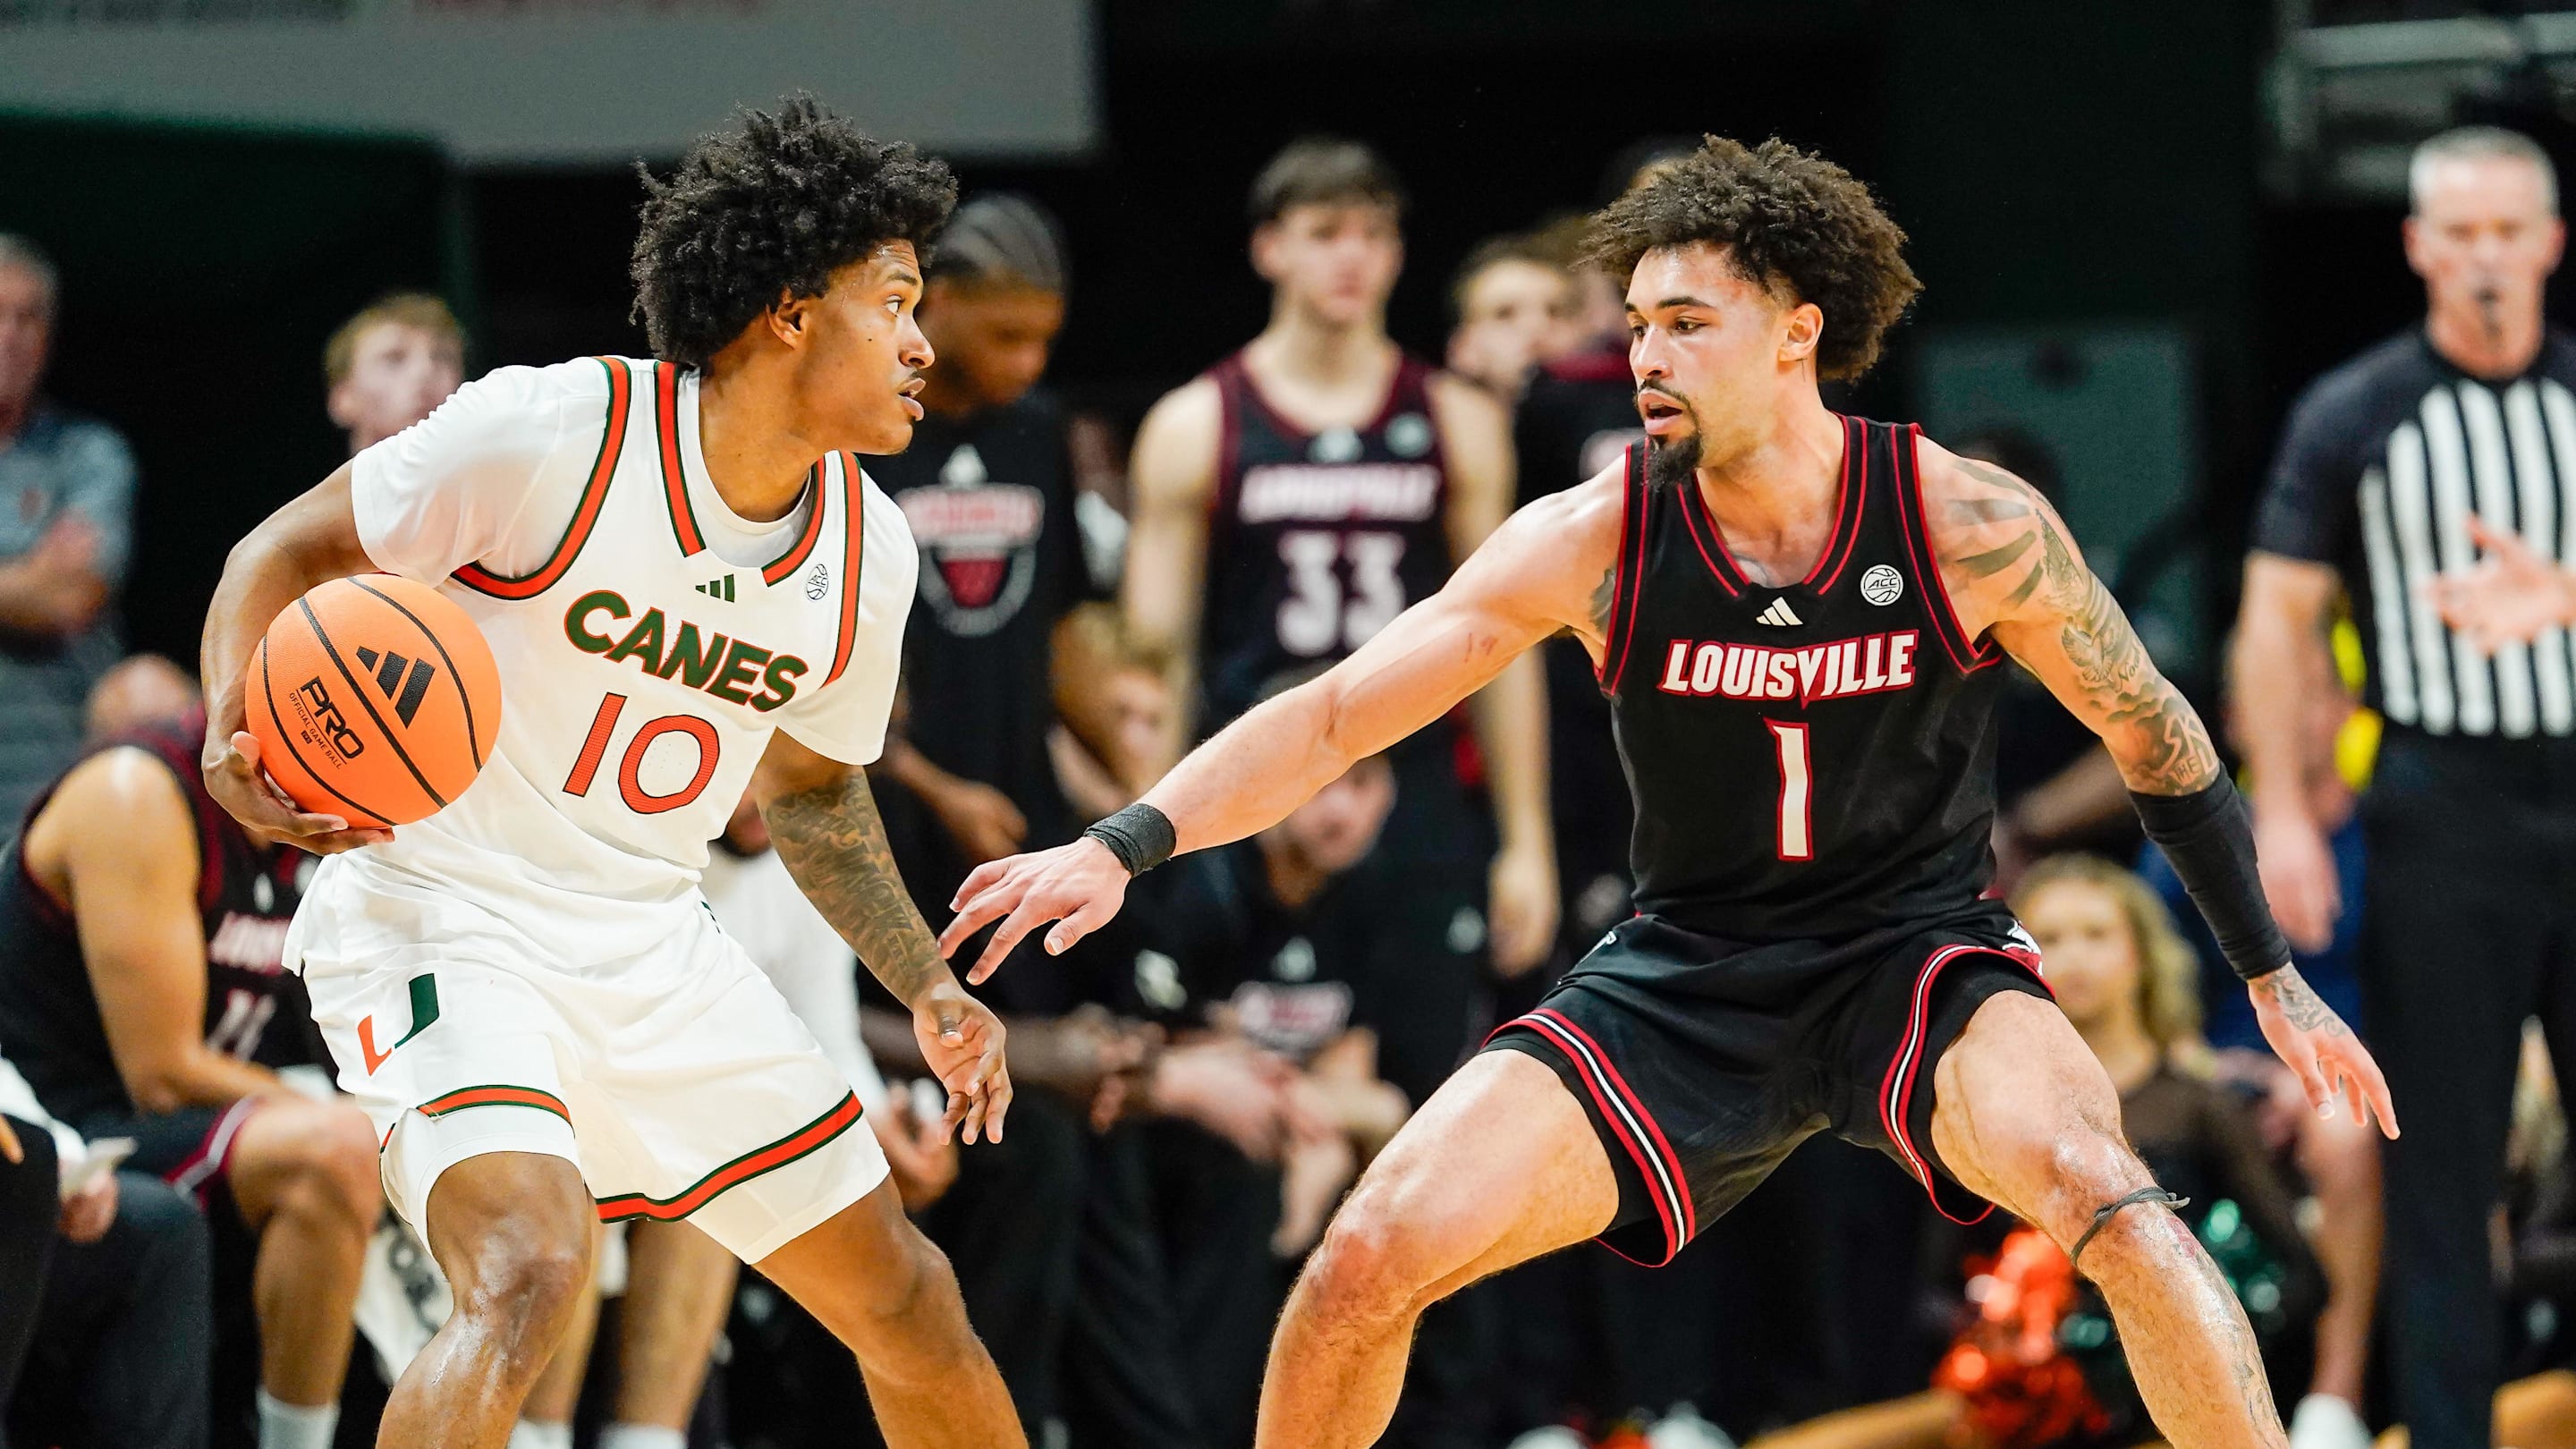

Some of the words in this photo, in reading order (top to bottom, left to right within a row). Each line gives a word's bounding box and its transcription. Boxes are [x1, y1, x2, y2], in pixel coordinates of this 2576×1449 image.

[1276, 530, 1405, 657] 33
[1868, 577, 1897, 589] ACC
[564, 589, 809, 713] CANES
[1657, 629, 1919, 709] LOUISVILLE
[289, 692, 310, 728] OFFICIAL
[309, 728, 327, 750] GAME
[326, 750, 343, 770] BALL
[301, 675, 364, 759] PRO
[562, 691, 720, 815] 10
[1763, 716, 1814, 861] 1
